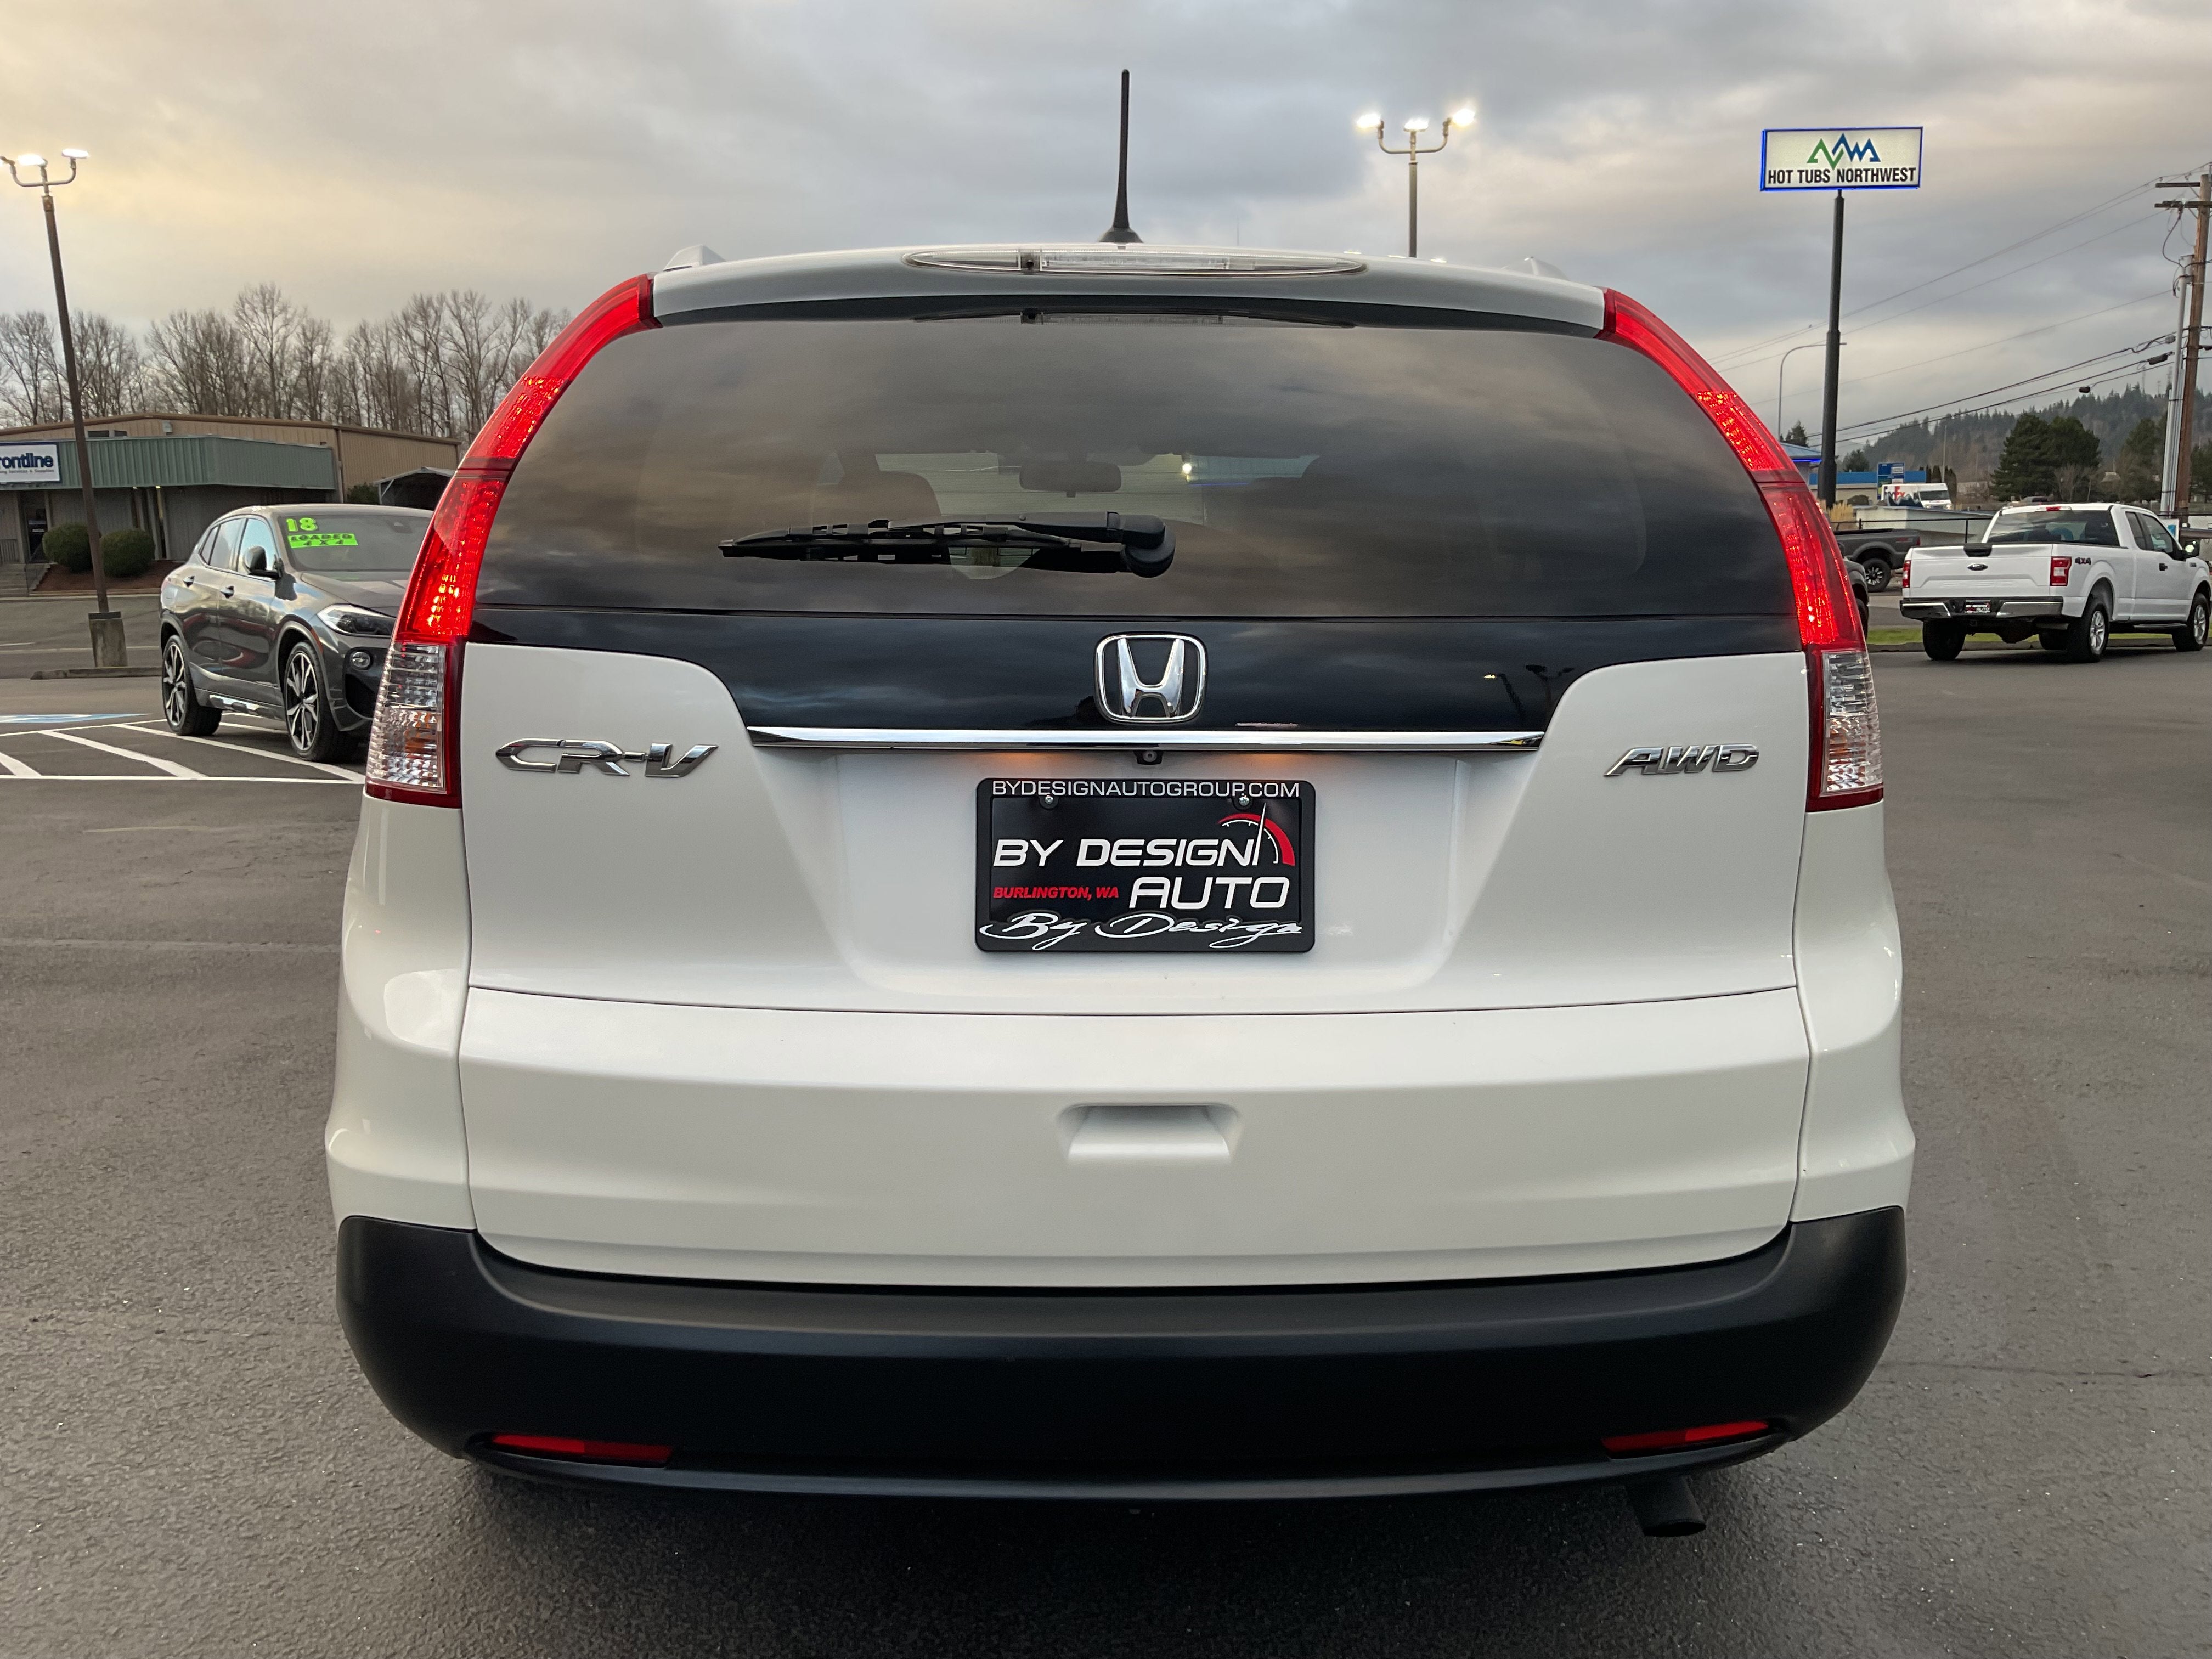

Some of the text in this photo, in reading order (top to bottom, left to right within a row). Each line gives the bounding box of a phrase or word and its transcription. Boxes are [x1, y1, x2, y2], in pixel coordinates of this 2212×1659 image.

[1768, 167, 1916, 184] HOT TUBS NORTHWEST
[0, 453, 53, 469] ontline
[286, 517, 318, 532] 18
[495, 738, 718, 777] CR-V
[1603, 743, 1759, 776] AWD
[992, 780, 1300, 797] BYDESIGNAUTOGROUP.COM
[994, 839, 1255, 866] BY DESIGN
[993, 887, 1119, 901] BURLINGTON, WA
[1129, 877, 1290, 909] AUTO
[979, 913, 1302, 950] By Design
